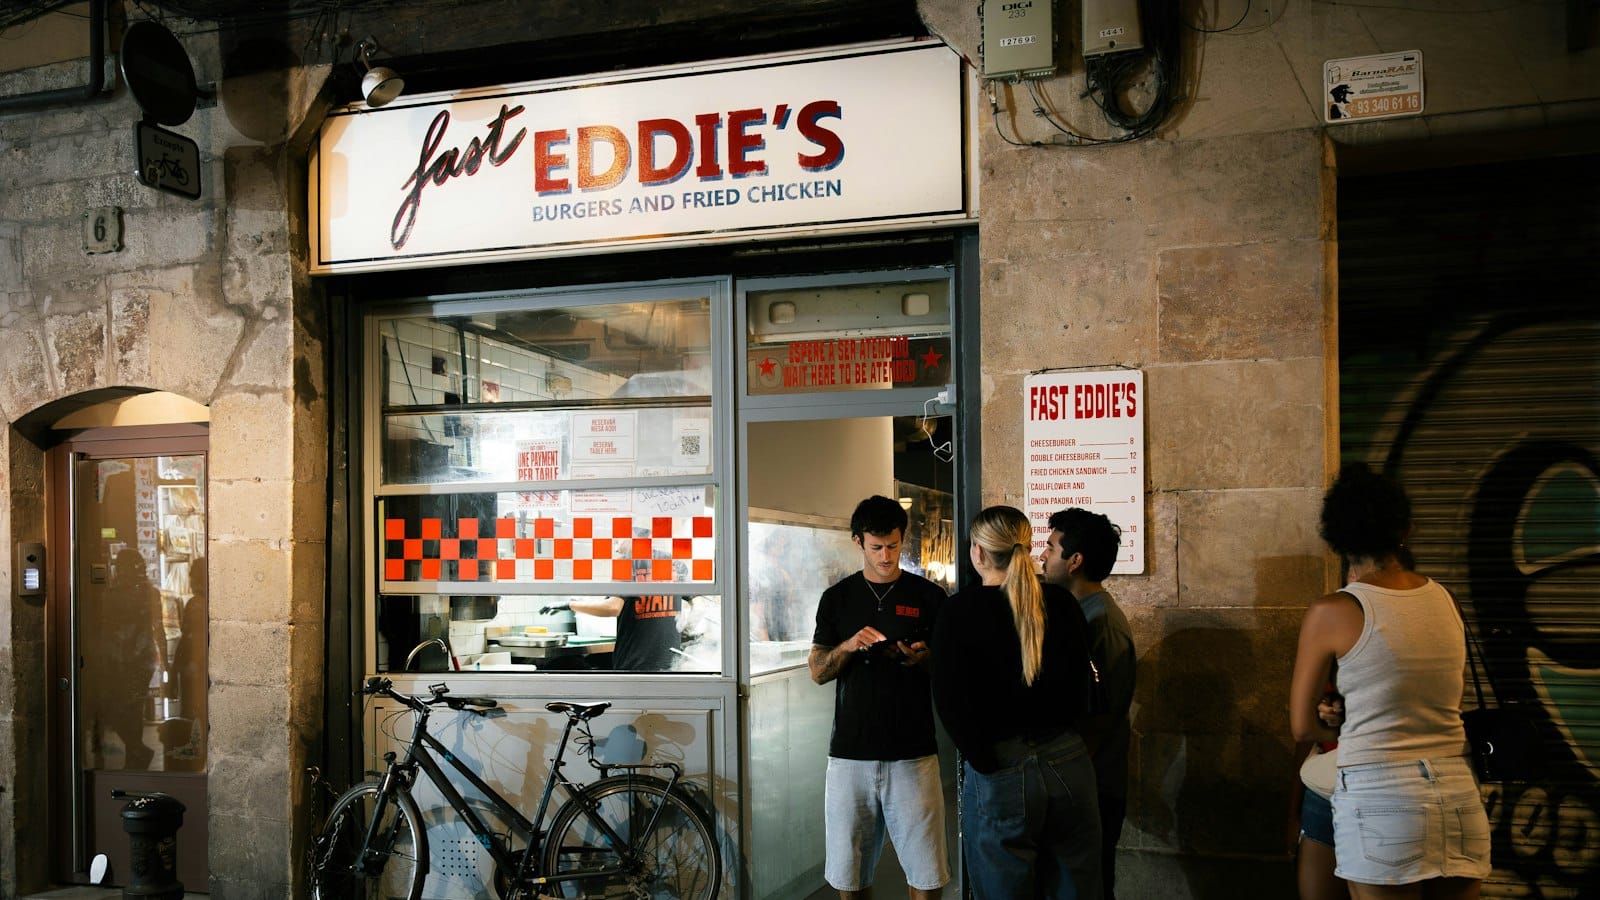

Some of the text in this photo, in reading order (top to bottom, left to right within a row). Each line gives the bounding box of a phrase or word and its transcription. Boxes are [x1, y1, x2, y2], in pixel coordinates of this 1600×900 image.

[1002, 1, 1032, 11] DIGI
[1008, 9, 1026, 19] 233
[1101, 28, 1124, 37] 1441
[1002, 36, 1036, 46] 127698
[1358, 95, 1418, 114] 93 340 61 16
[391, 100, 845, 251] fast EDDIE'S
[532, 179, 843, 222] BURGERS AND FRIED CHICKEN
[94, 217, 106, 242] 6
[789, 336, 908, 363] ESPERE A SER ATENDIDO
[783, 365, 808, 388] WAIT
[811, 364, 836, 386] HERE
[839, 363, 851, 384] TO
[855, 362, 867, 384] BE
[1031, 382, 1137, 421] FAST EDDIE'S
[1031, 439, 1076, 448] CHEESEBURGER
[530, 450, 558, 467] PAYMENT
[1031, 452, 1137, 462] DOUBLE CHEESEBURGER 12
[518, 467, 559, 481] PER TABLE
[1048, 468, 1075, 476] CHICKEN
[1075, 467, 1107, 476] SANDWICH
[1031, 482, 1085, 491] CAULIFLOWER AND
[1031, 497, 1049, 506] ONION
[1050, 497, 1074, 505] PAKORA
[1031, 512, 1045, 520] FISH
[1130, 525, 1137, 533] 10
